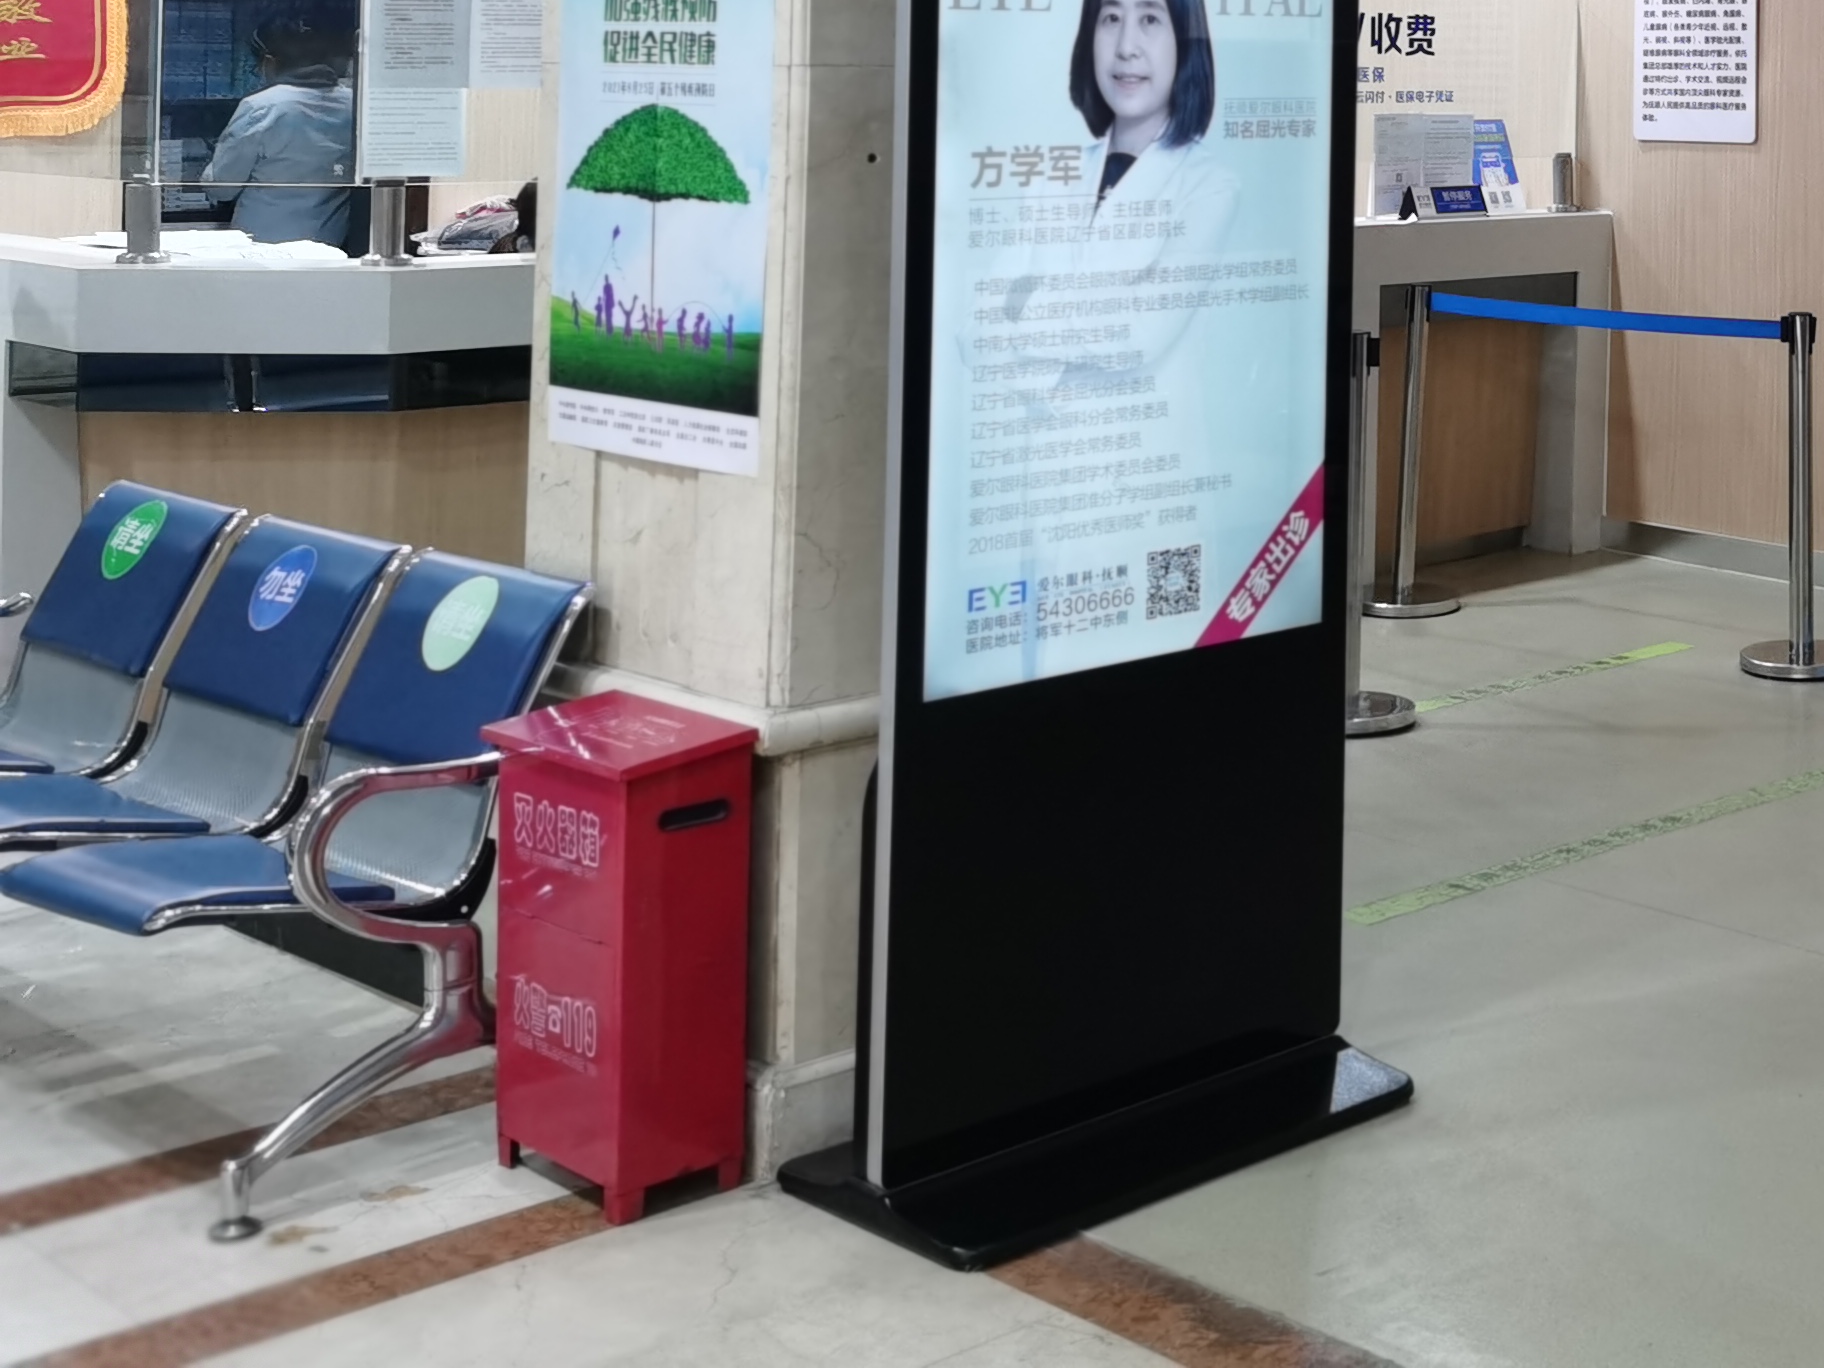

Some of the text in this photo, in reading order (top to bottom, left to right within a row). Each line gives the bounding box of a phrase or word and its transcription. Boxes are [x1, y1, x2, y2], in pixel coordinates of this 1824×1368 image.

[603, 30, 716, 65] 促进全民健康
[1223, 118, 1316, 139] 知名屈光专家
[970, 145, 1083, 189] 方学军
[1225, 509, 1310, 623] 专家出诊
[514, 792, 600, 867] 灭火器箱
[562, 997, 597, 1057] 119
